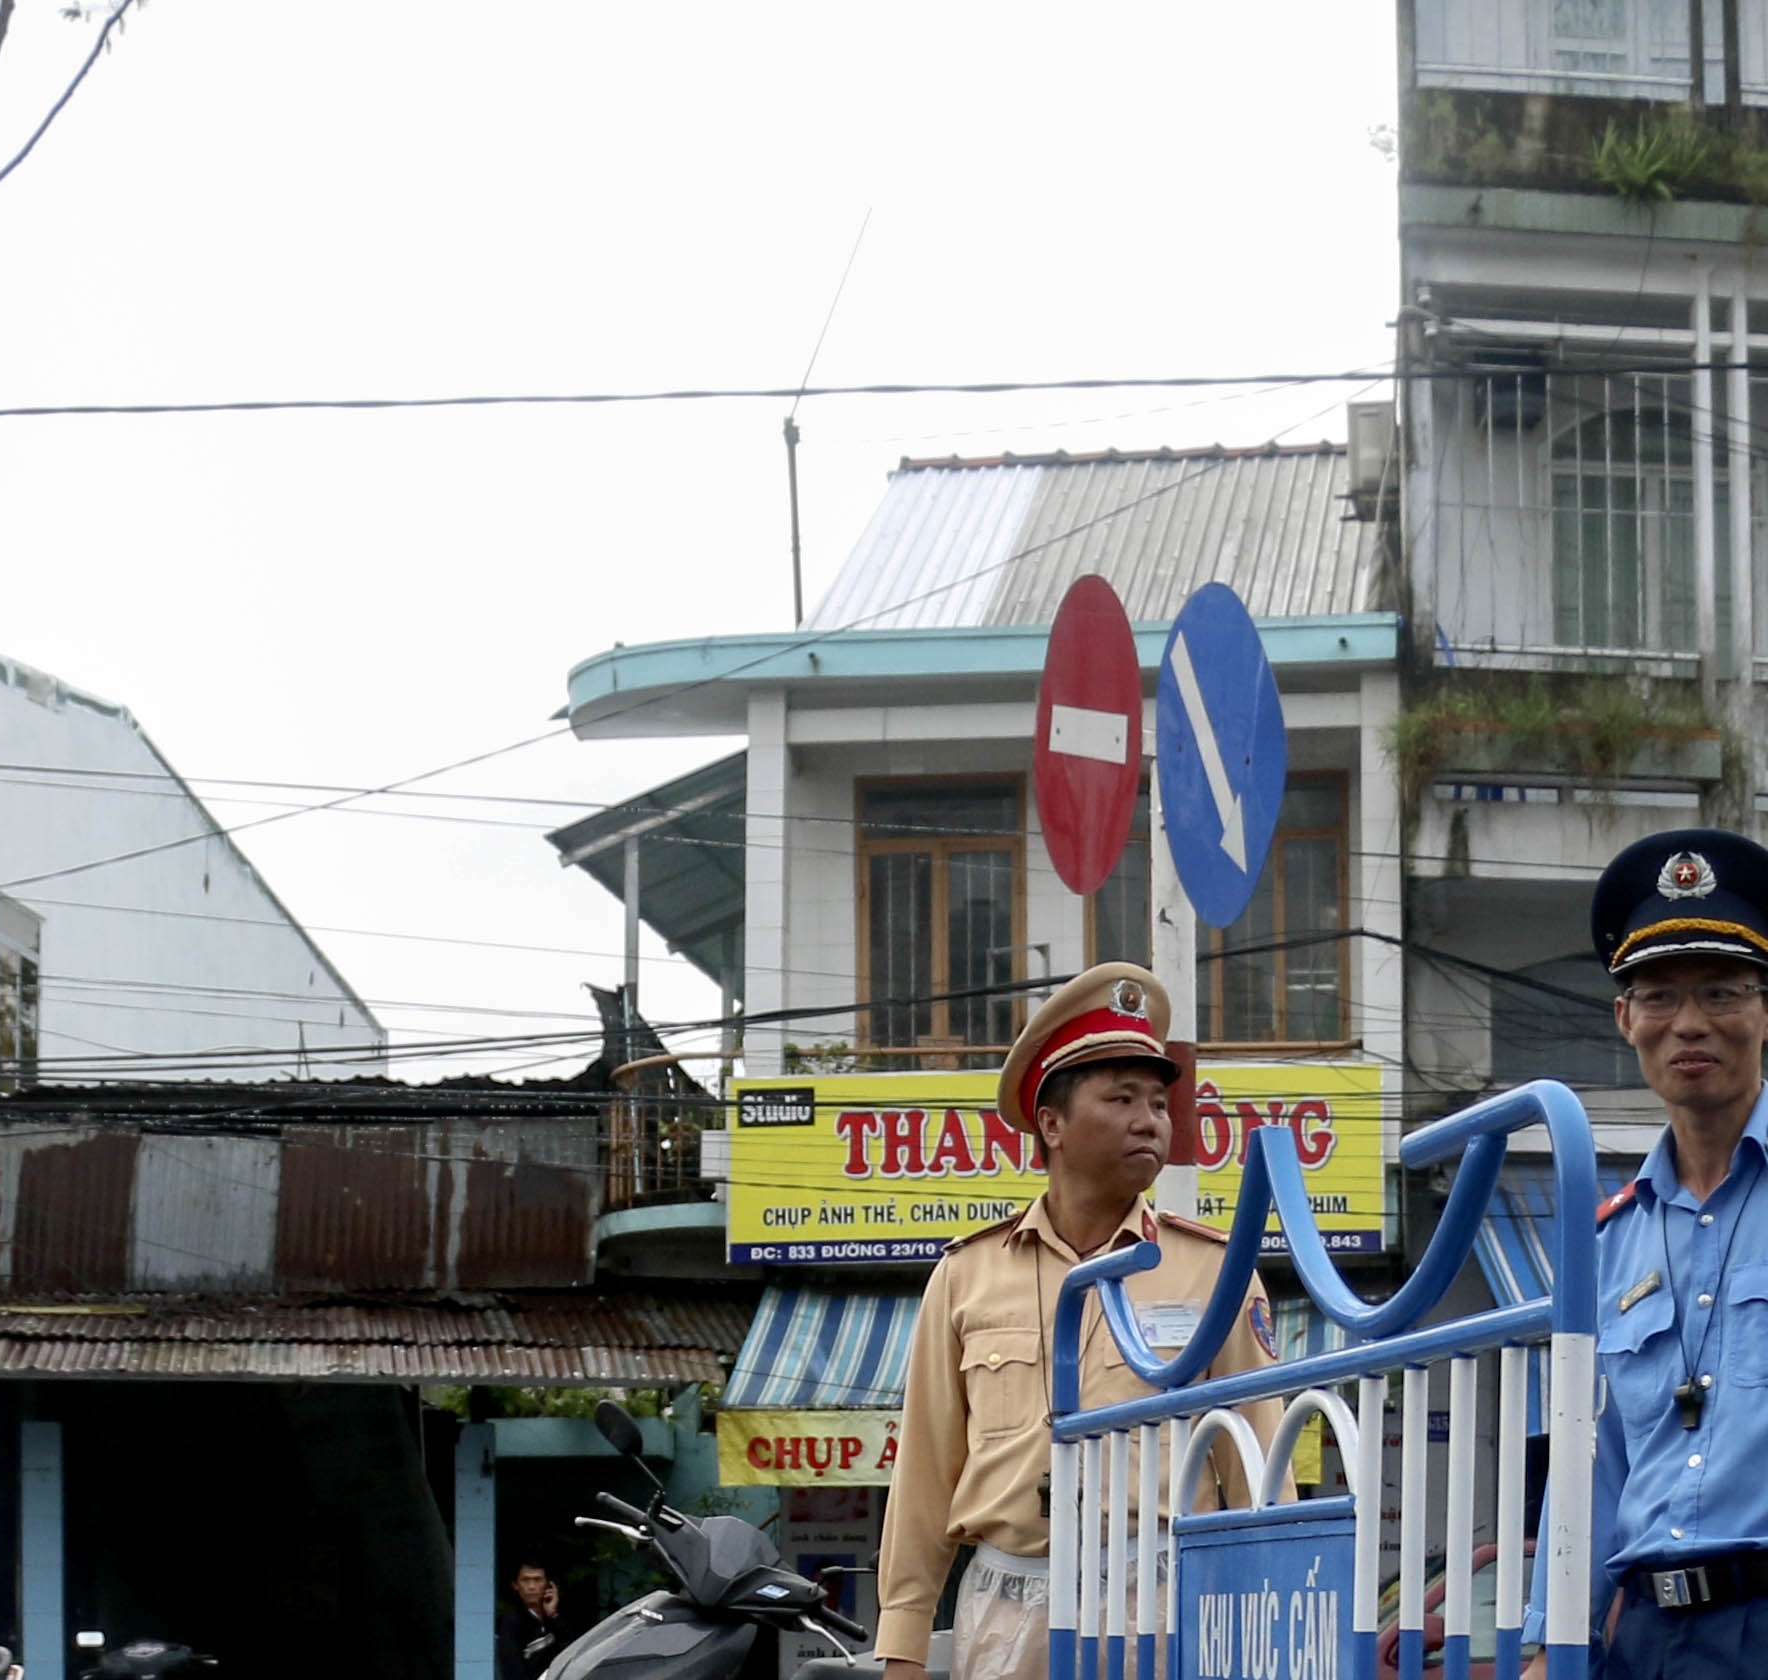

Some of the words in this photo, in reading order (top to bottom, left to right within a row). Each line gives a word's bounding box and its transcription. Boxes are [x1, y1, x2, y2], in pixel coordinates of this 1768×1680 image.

[741, 1094, 811, 1124] Studio
[763, 1206, 811, 1231] CHỤP
[818, 1199, 854, 1226] ẢNH
[910, 1198, 960, 1223] CHÂN
[751, 1244, 782, 1260] ĐC:
[788, 1244, 816, 1259] 833
[821, 1240, 887, 1258] ĐƯỜNG
[890, 1242, 936, 1258] 23/10
[746, 1436, 864, 1478] CHỤP
[1199, 1593, 1233, 1678] KHU
